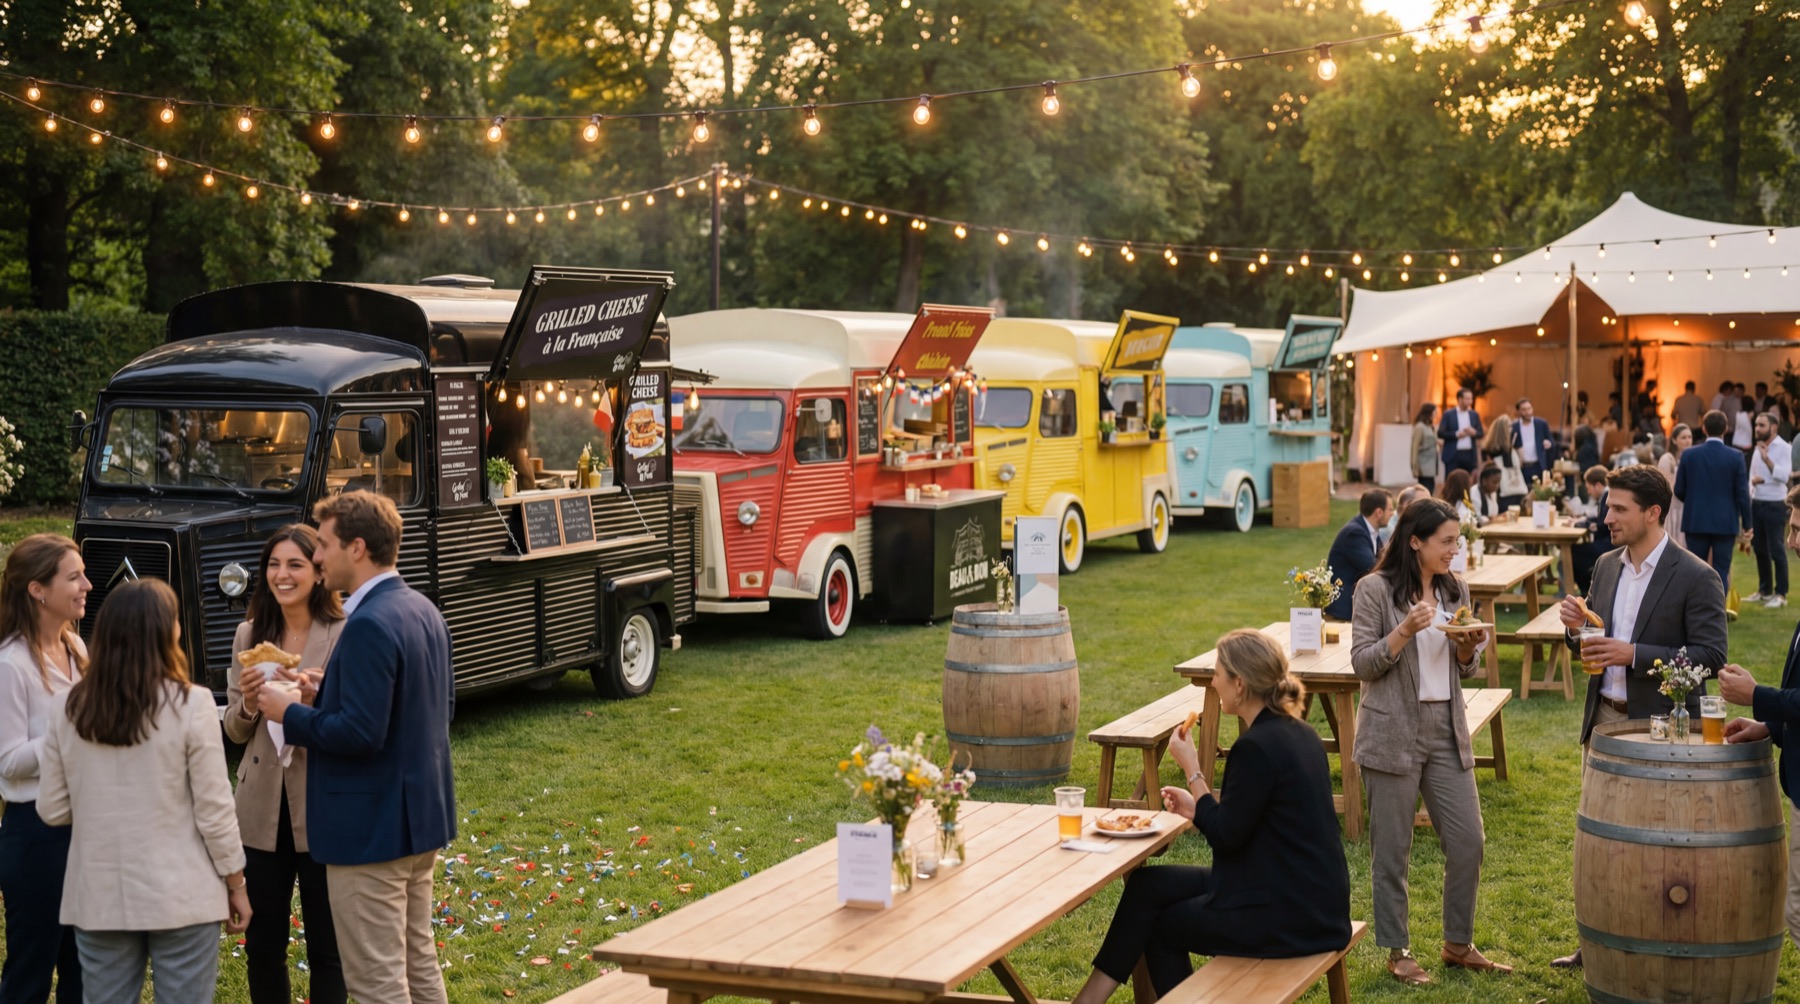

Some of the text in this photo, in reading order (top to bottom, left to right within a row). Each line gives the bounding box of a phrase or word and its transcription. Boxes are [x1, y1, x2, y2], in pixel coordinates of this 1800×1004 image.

[535, 293, 649, 333] GRILLED CHEESE
[542, 324, 625, 355] à la Française
[628, 374, 660, 386] GRILLED
